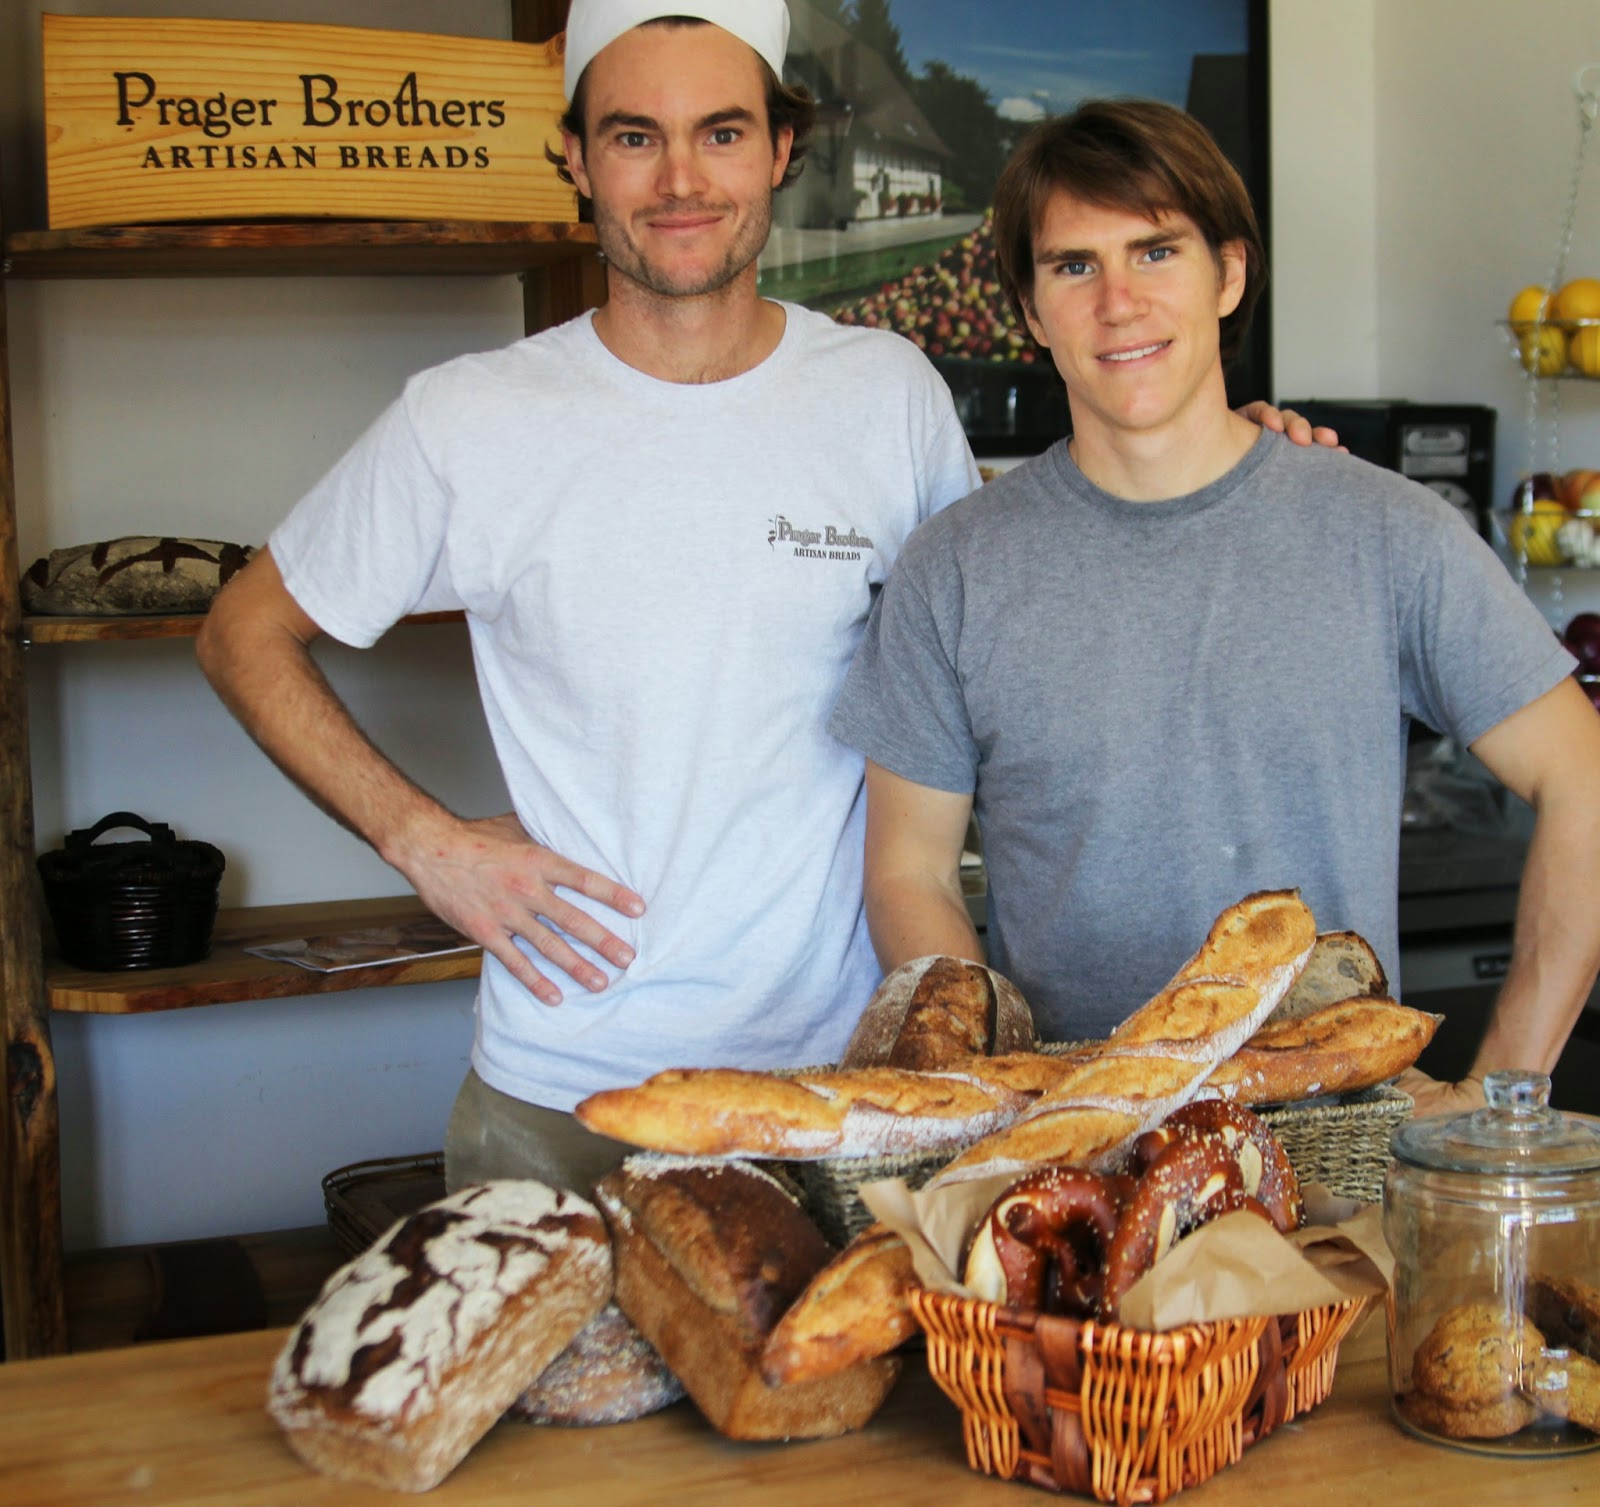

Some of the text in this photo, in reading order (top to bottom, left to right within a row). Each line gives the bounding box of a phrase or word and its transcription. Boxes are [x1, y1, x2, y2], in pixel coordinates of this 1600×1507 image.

[113, 71, 506, 138] Prager Brothers
[142, 145, 490, 169] ARTISAN BREADS
[777, 520, 821, 547] Prager
[793, 547, 861, 561] ARTISAN BREADS
